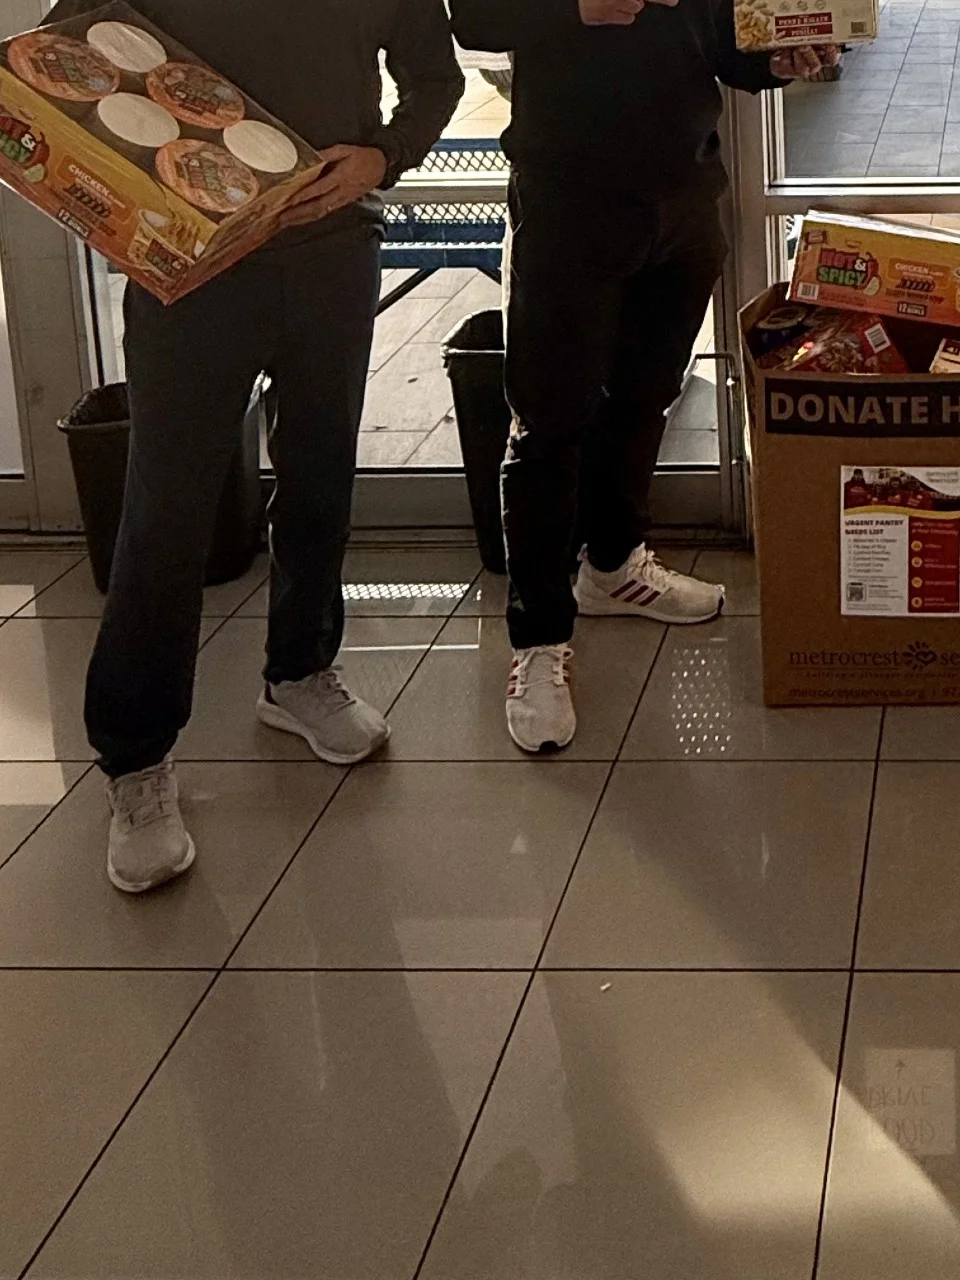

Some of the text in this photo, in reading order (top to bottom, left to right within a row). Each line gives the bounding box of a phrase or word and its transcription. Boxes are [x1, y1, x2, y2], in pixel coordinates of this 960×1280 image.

[68, 164, 111, 196] CHICKEN
[820, 248, 856, 267] HOT
[818, 267, 866, 287] SPICY
[895, 262, 929, 274] CHICKEN
[770, 392, 929, 424] DONATE
[789, 648, 900, 666] metrocrest
